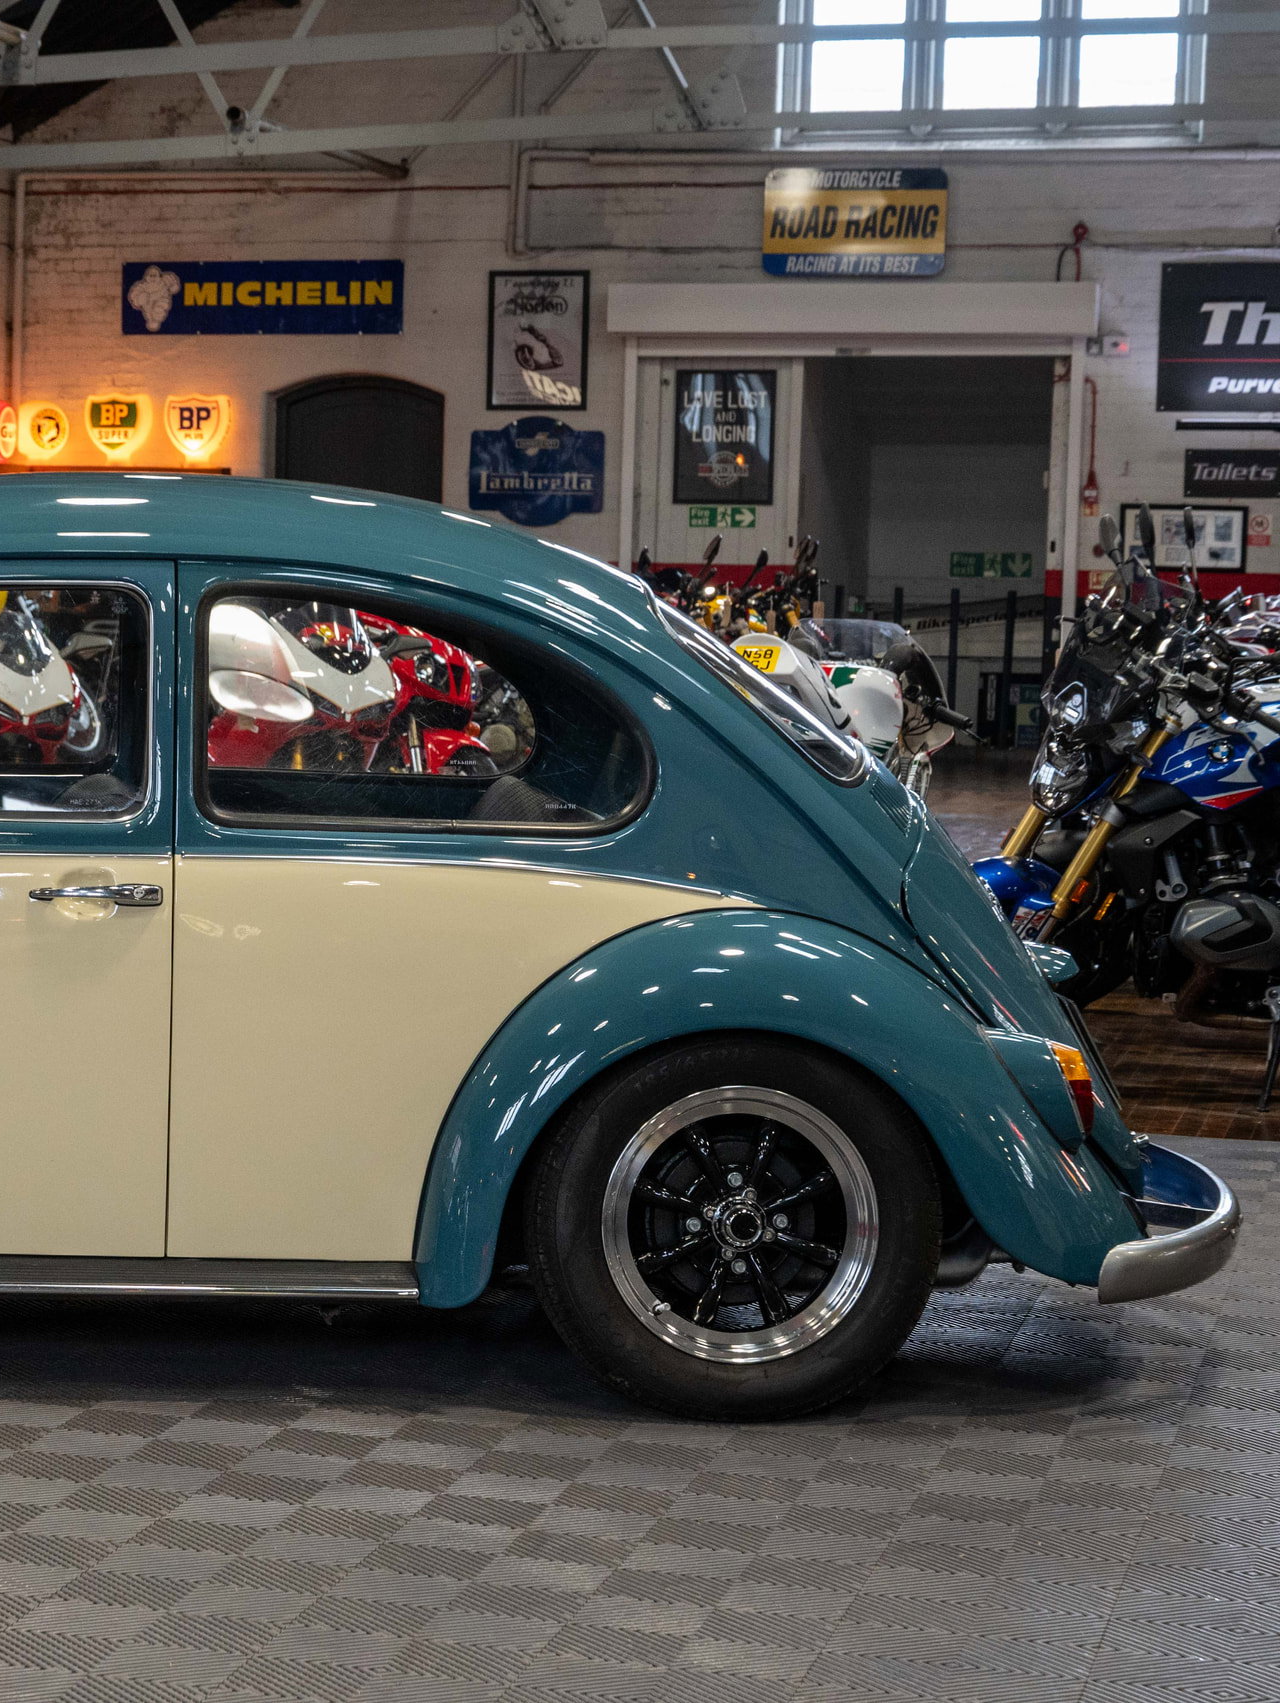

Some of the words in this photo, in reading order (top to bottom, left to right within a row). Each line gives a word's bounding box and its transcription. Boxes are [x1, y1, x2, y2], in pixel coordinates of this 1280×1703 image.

[811, 170, 903, 188] MOTORCYCLE
[770, 205, 839, 239] ROAD
[843, 204, 940, 239] RACING
[786, 255, 836, 272] RACING
[839, 255, 856, 273] AT
[858, 255, 882, 273] ITS
[884, 255, 919, 273] BEST
[183, 280, 393, 307] MICHELIN
[683, 390, 723, 408] LOVE
[727, 390, 768, 408] LOST
[99, 403, 129, 426] BP
[715, 411, 737, 423] AND
[98, 430, 129, 440] SUPER
[692, 425, 756, 443] LONGING
[1193, 462, 1278, 481] Toilets
[478, 470, 595, 494] Lambretta
[691, 508, 710, 518] Fire
